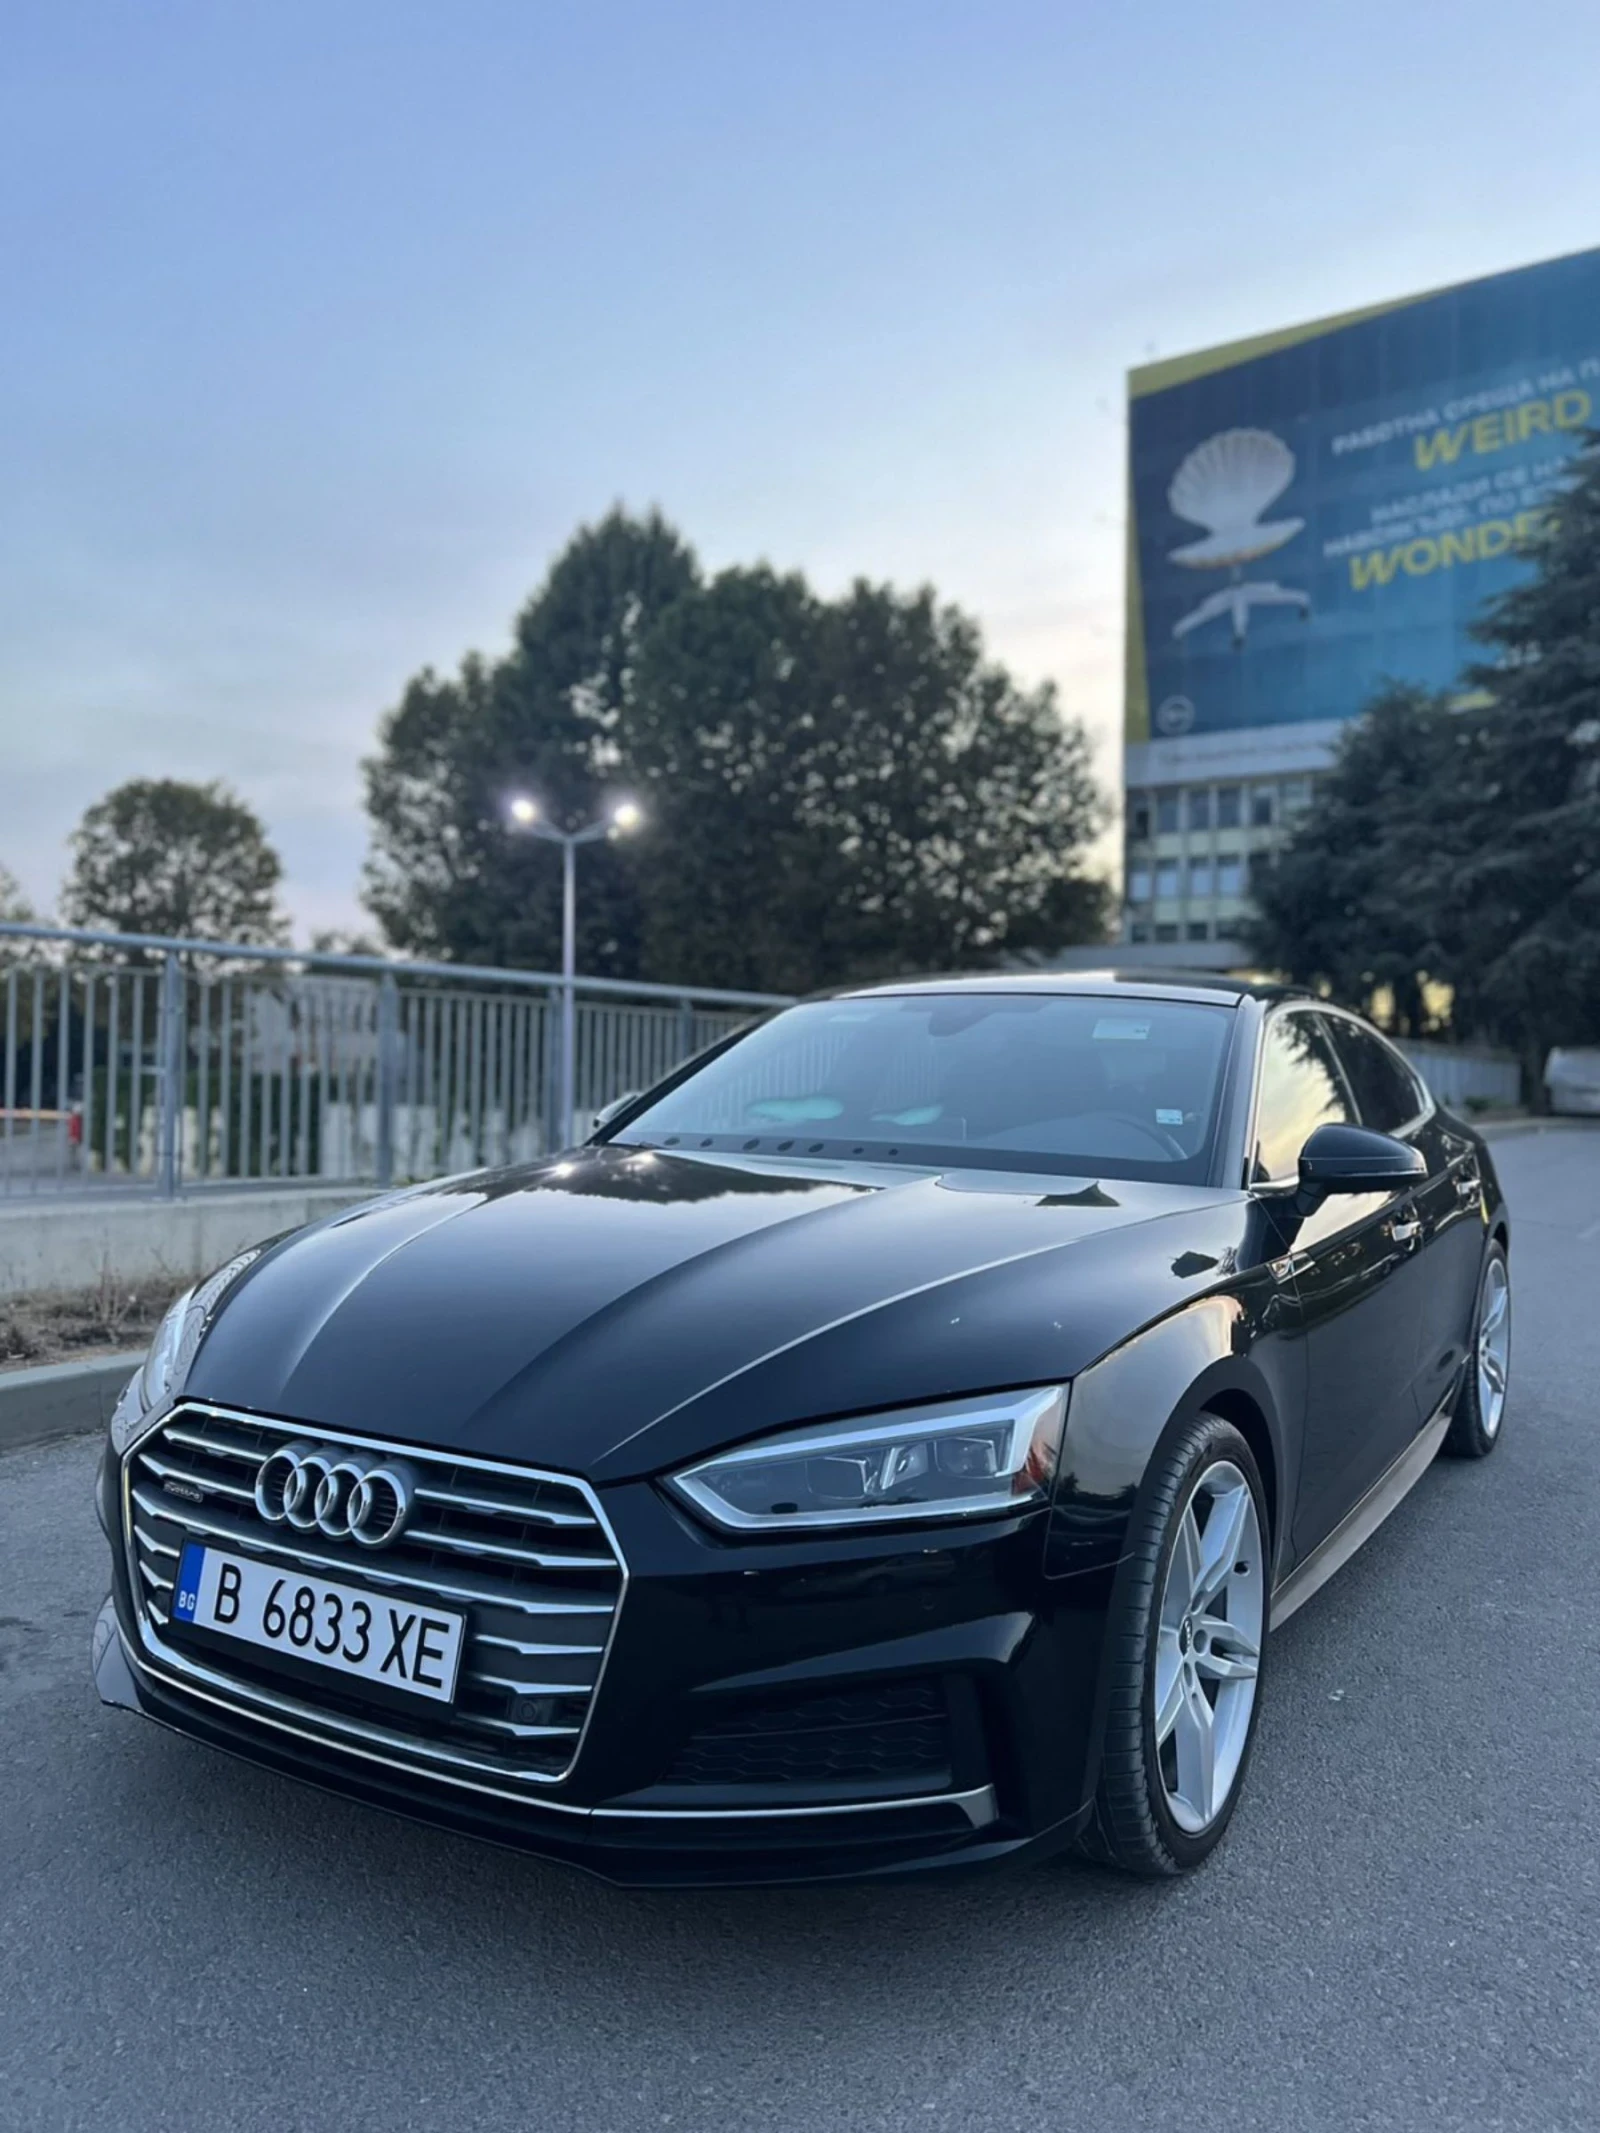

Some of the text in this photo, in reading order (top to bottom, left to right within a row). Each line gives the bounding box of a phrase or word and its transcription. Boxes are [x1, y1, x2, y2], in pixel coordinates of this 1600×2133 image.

[1414, 390, 1591, 471] WEIRD
[1351, 506, 1562, 591] WONDE
[178, 1590, 196, 1611] BG
[214, 1562, 449, 1689] B 6833 XE
